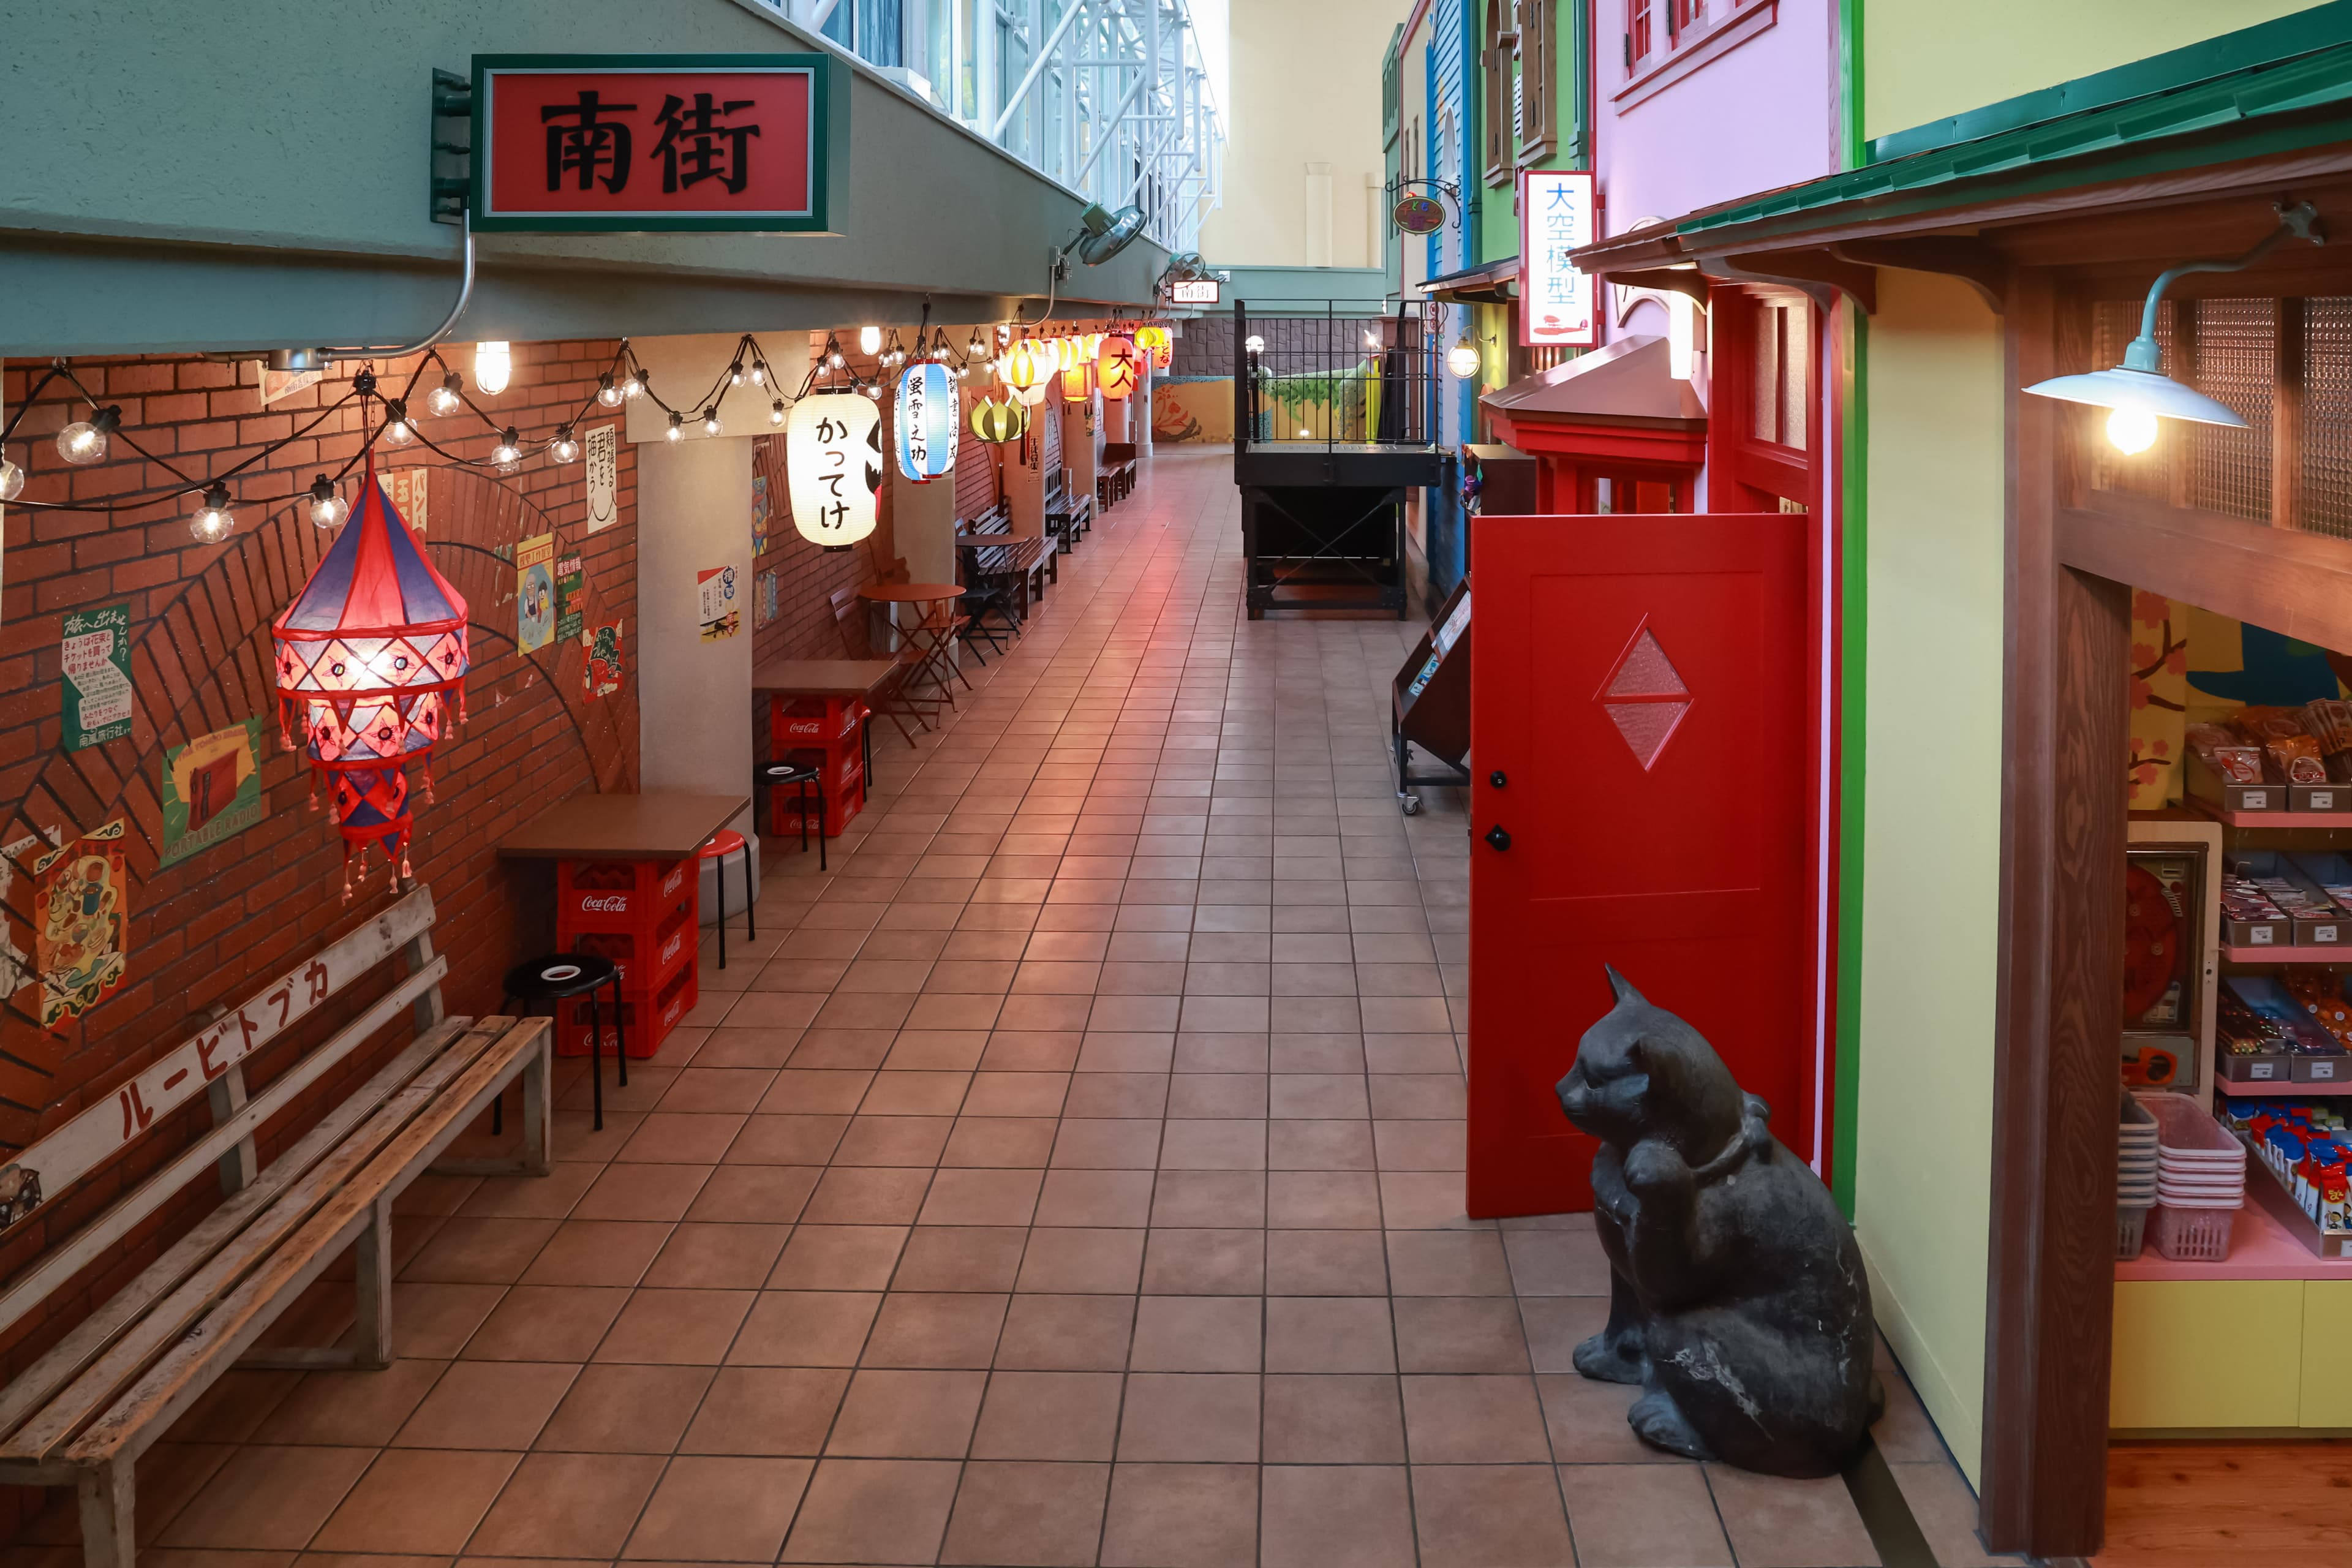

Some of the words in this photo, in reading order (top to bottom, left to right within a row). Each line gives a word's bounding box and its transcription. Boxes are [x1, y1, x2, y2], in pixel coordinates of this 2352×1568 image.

[541, 91, 760, 194] 南街
[1547, 183, 1575, 304] 大空模型
[1110, 348, 1133, 388] 大人
[597, 432, 606, 486] 君を
[816, 417, 850, 529] かってけ
[64, 633, 111, 651] きょうは花束と
[64, 645, 111, 663] チケットを買って
[790, 723, 820, 733] Coca-Cola
[165, 821, 221, 858] PORTABLE
[225, 804, 258, 832] RADIO
[582, 895, 627, 911] Coca-Cola
